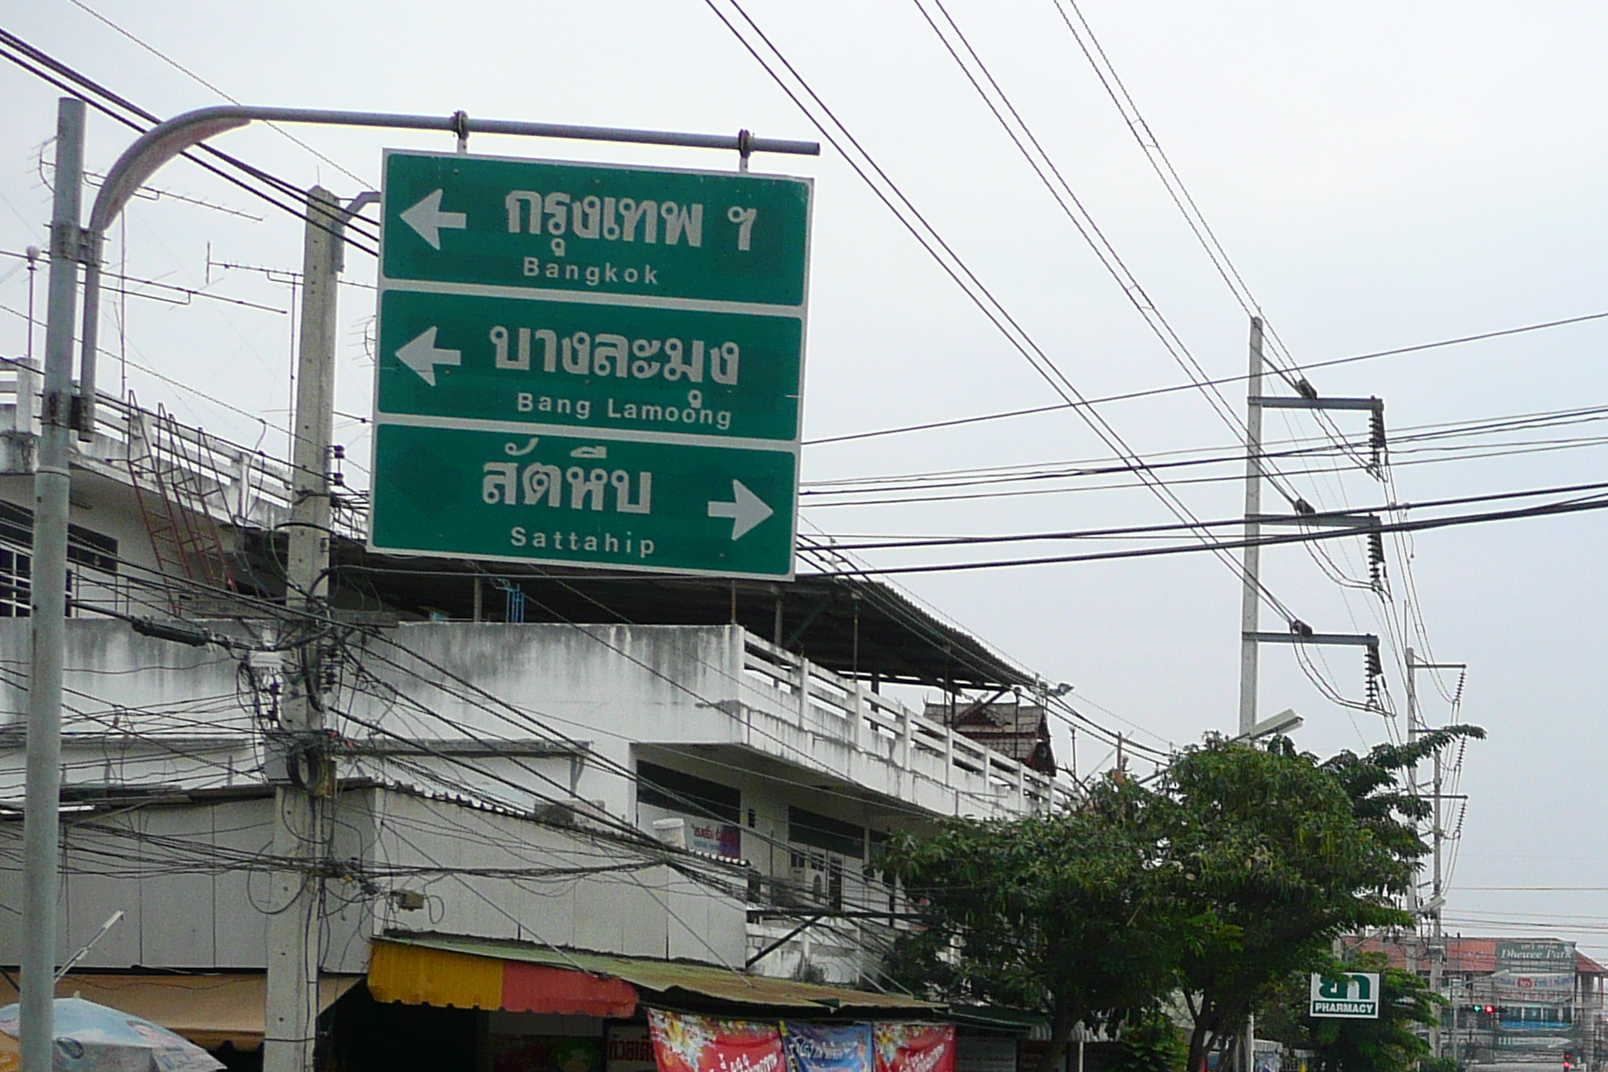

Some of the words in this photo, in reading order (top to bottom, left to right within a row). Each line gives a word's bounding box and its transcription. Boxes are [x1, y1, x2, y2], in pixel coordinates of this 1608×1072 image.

[505, 190, 703, 257] กรุงเทพ
[523, 256, 658, 286] Bangkok
[489, 326, 740, 409] บางละมุง
[517, 393, 591, 419] Bang
[607, 398, 732, 430] Lamoong
[482, 437, 652, 514] สัตหีบ
[510, 526, 655, 558] Sattahip
[1315, 1002, 1374, 1013] PHARMACY
